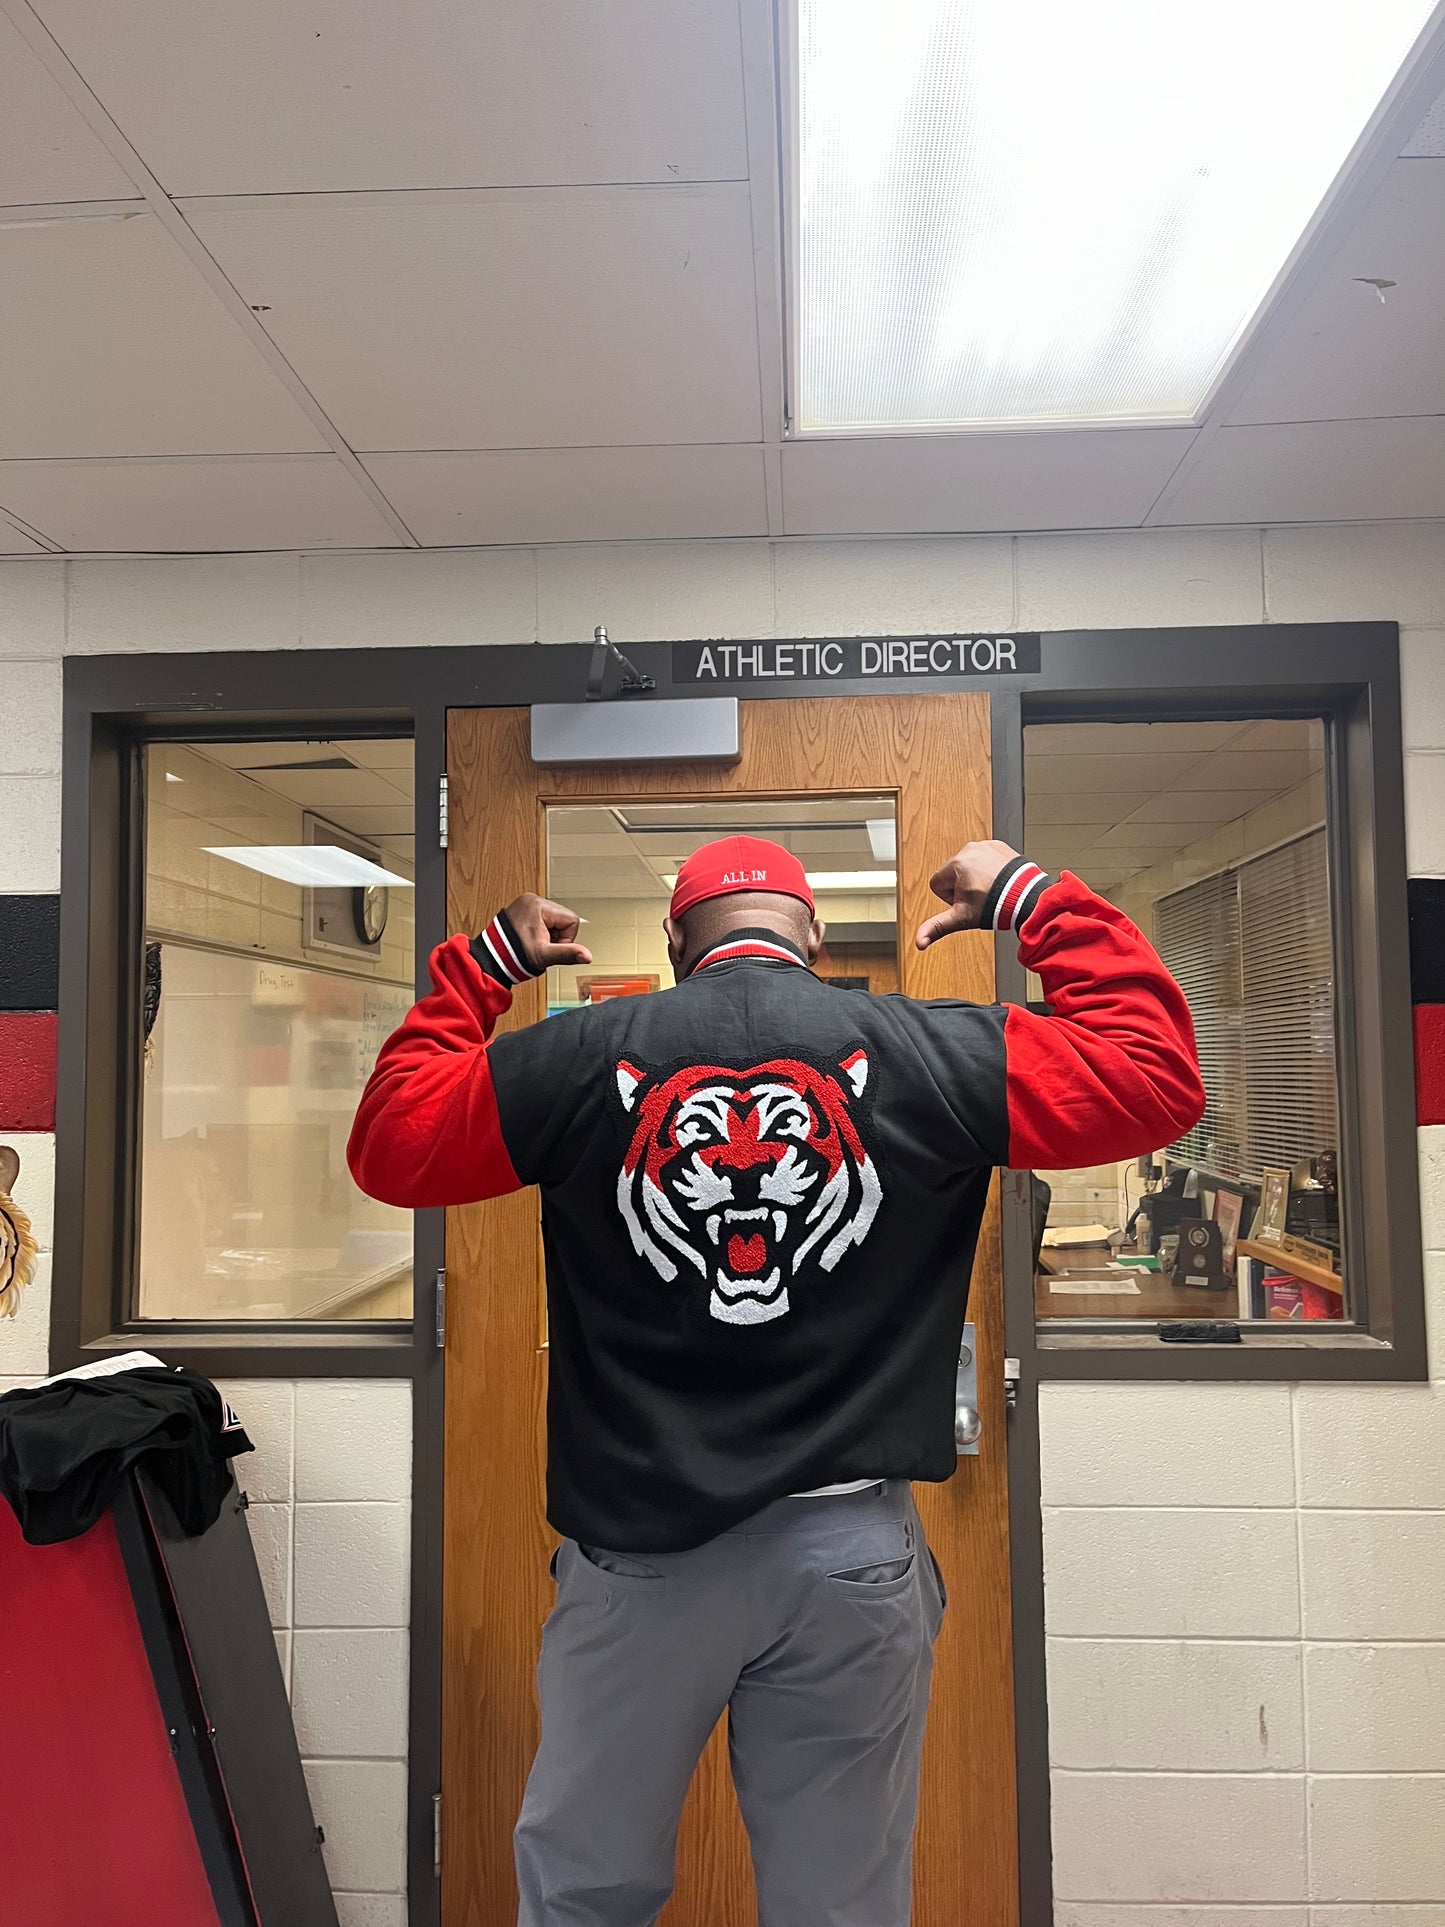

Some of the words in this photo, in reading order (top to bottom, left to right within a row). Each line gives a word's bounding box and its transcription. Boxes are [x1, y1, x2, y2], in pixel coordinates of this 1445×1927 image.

[696, 643, 844, 678] ATHLETIC
[861, 638, 1017, 674] DIRECTOR
[721, 871, 749, 884] ALL
[751, 870, 767, 881] IN
